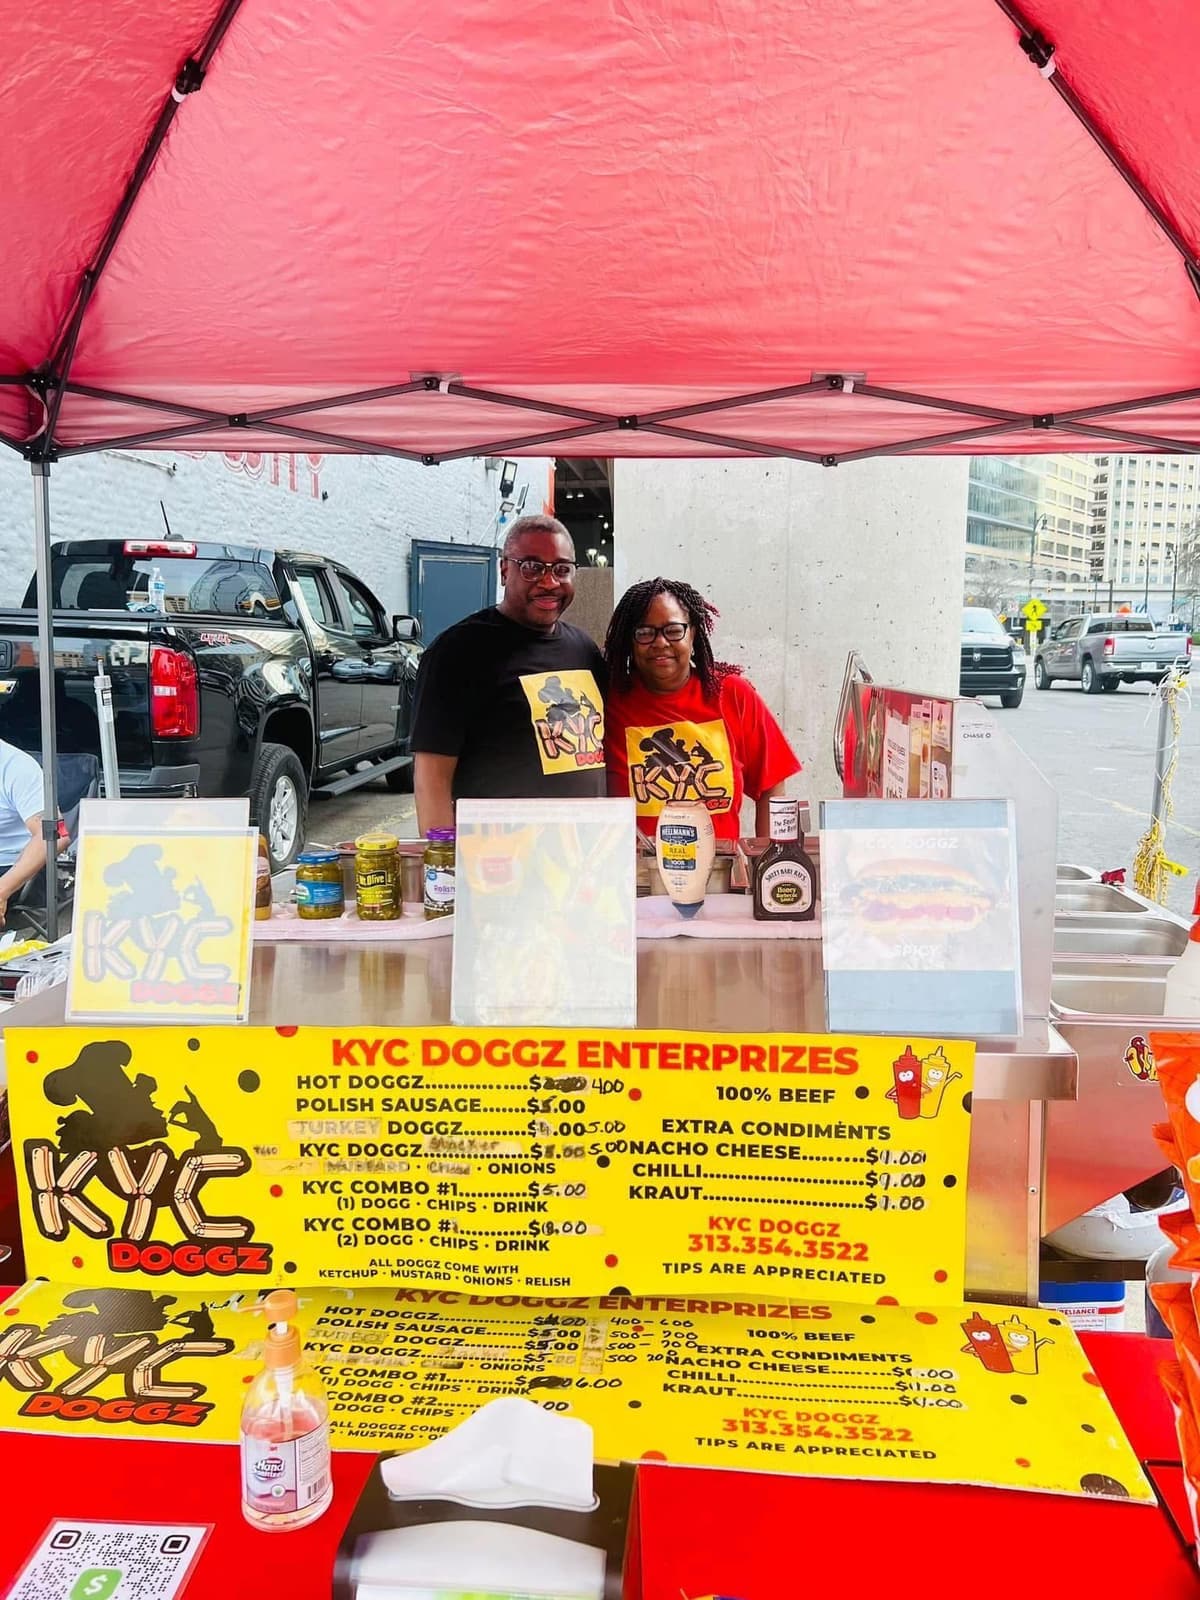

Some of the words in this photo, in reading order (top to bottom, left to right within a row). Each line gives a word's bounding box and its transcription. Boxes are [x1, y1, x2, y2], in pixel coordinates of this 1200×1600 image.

[535, 711, 604, 759] KYC
[576, 751, 605, 766] DOG
[631, 760, 726, 804] KYC
[84, 911, 234, 983] KYC
[332, 1038, 410, 1068] KYC
[421, 1039, 567, 1069] DOGGZ
[578, 1041, 859, 1076] ENTERPRIZES
[297, 1075, 341, 1090] HOT
[348, 1075, 424, 1090] DOGGZ
[715, 1086, 772, 1102] 100%
[779, 1087, 836, 1104] BEEF
[296, 1097, 375, 1113] POLISH
[381, 1097, 482, 1113] SAUSAGE
[296, 1120, 379, 1135] TURKEY
[387, 1121, 464, 1136] DOGGZ
[661, 1118, 734, 1136] EXTRA
[740, 1120, 892, 1141] CONDIMENTS
[299, 1143, 341, 1158] KYC
[347, 1143, 423, 1158] DOGGZ
[630, 1140, 709, 1158] NACHO
[715, 1142, 802, 1161] CHEESE
[487, 1162, 556, 1174] ONIONS
[632, 1163, 703, 1179] CHILLI
[24, 1138, 255, 1241] KYC
[302, 1180, 344, 1195] KYC
[350, 1180, 430, 1196] COMBO
[436, 1181, 458, 1196] #1
[629, 1185, 703, 1200] KRAUT
[336, 1197, 356, 1211] (1)
[361, 1198, 411, 1209] DOGG
[426, 1199, 477, 1213] CHIPS
[493, 1201, 548, 1213] DRINK
[303, 1217, 345, 1232] KYC
[350, 1217, 431, 1233] COMBO
[708, 1216, 752, 1233] KYC
[759, 1217, 840, 1238] DOGGZ
[337, 1234, 359, 1248] (2)
[364, 1235, 414, 1247] DOGG
[429, 1236, 479, 1251] CHIPS
[495, 1240, 550, 1252] DRINK
[687, 1233, 870, 1263] 313.354.3522
[108, 1242, 271, 1275] DOGGZ
[368, 1258, 393, 1268] ALL
[396, 1259, 441, 1270] DOGGZ
[444, 1261, 480, 1274] COME
[484, 1265, 519, 1275] WITH
[318, 1268, 379, 1279] KETCHUP
[390, 1269, 452, 1282] MUSTARD
[463, 1275, 514, 1287] ONIONS
[525, 1277, 571, 1288] RELISH
[662, 1262, 703, 1275] TIPS
[709, 1263, 746, 1275] ARE
[752, 1264, 887, 1286] APPRECIATED
[395, 1288, 464, 1305] KYC
[468, 1294, 590, 1310] DOGGZ
[598, 1297, 833, 1321] ENTERPRIZES
[324, 1306, 367, 1316] HOT
[370, 1308, 440, 1322] DOGGZ
[316, 1317, 389, 1330] POLISH
[393, 1322, 488, 1336] SAUSAGE
[393, 1334, 465, 1347] DOGGZ
[745, 1328, 798, 1341] 100%
[803, 1331, 857, 1343] BEEF
[303, 1342, 345, 1352] KYC
[348, 1345, 422, 1358] DOGGZ
[695, 1344, 765, 1359] EXTRA
[771, 1347, 913, 1364] CONDIMENTS
[0, 1325, 233, 1400] KYC
[479, 1362, 545, 1373] ONIONS
[665, 1356, 742, 1370] NACHO
[747, 1361, 831, 1376] CHEESE
[339, 1367, 419, 1380] COMBO
[423, 1372, 447, 1382] #1
[666, 1369, 735, 1384] CHILLI
[343, 1379, 394, 1389] DOGG
[409, 1382, 462, 1393] CHIPS
[476, 1386, 531, 1396] DRINK
[662, 1383, 738, 1398] KRAUT
[326, 1391, 405, 1404] COMBO
[410, 1395, 438, 1406] #2
[22, 1394, 211, 1425] DOGGZ
[333, 1403, 385, 1414] DOGG
[401, 1407, 454, 1418] CHIPS
[742, 1406, 790, 1422] KYC
[795, 1409, 880, 1426] DOGGZ
[329, 1420, 355, 1428] ALL
[358, 1422, 407, 1431] DOGGZ
[409, 1424, 450, 1434] COME
[347, 1430, 415, 1440] MUSTARD
[722, 1418, 914, 1443] 313.354.3522
[694, 1436, 739, 1450] TIPS
[744, 1440, 787, 1453] ARE
[793, 1443, 937, 1460] APPRECIATED
